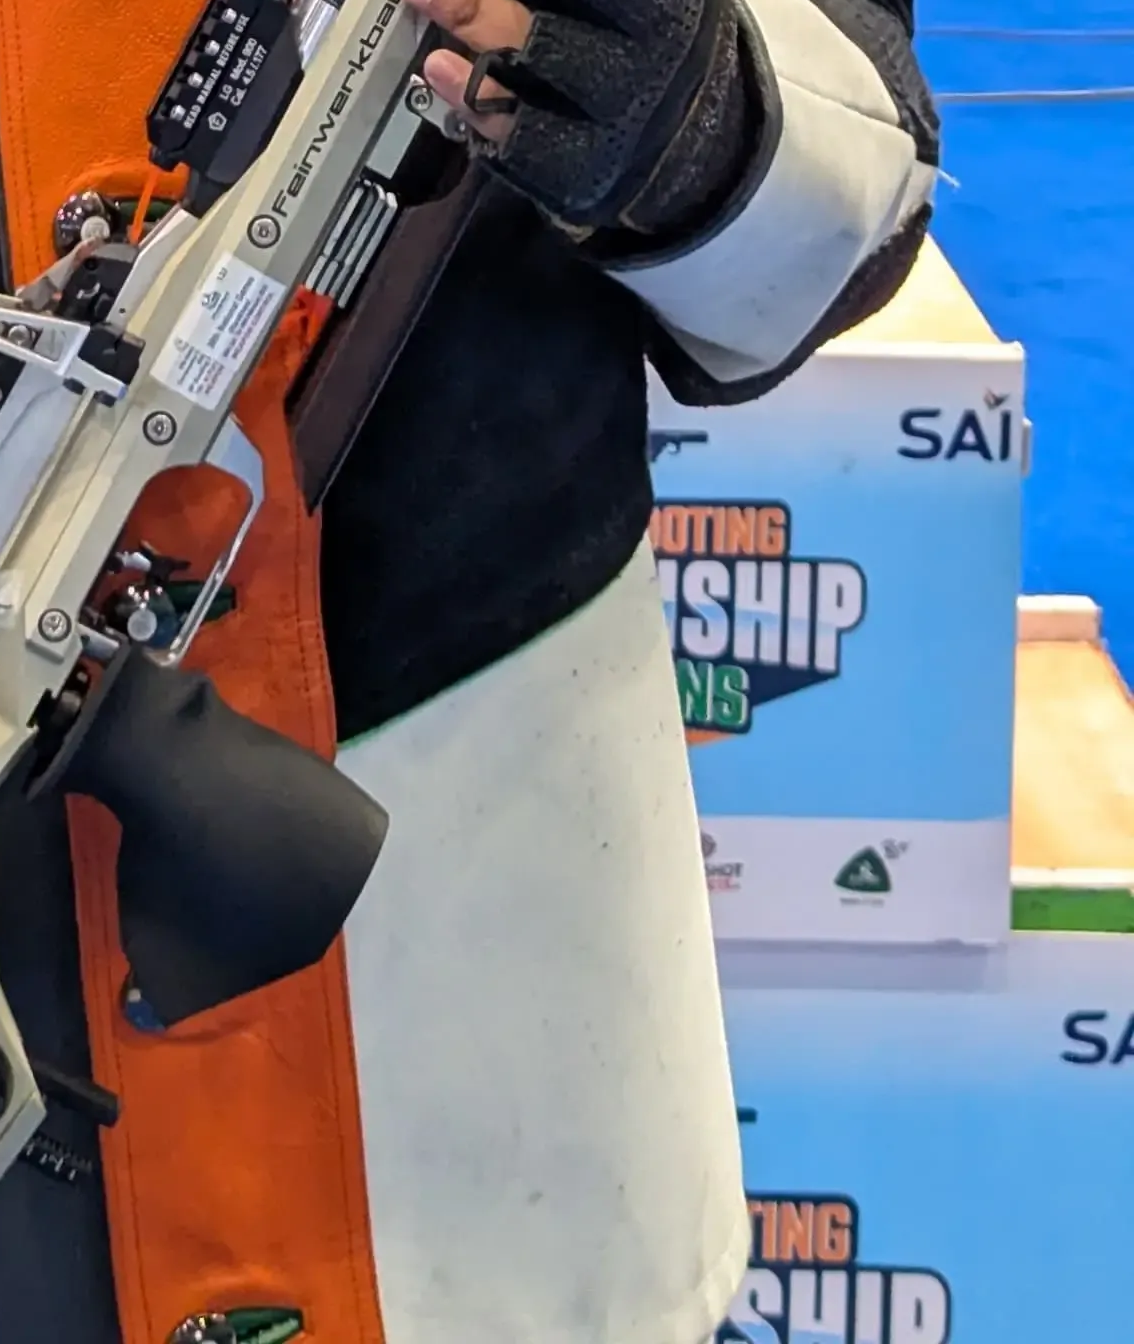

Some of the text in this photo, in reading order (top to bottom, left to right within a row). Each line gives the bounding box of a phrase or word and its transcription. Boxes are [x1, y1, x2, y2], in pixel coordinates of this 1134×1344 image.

[182, 104, 201, 129] READ
[195, 68, 221, 104] MANUAL
[215, 32, 239, 67] BEFORE
[218, 83, 233, 100] LG
[897, 409, 1011, 461] SAI
